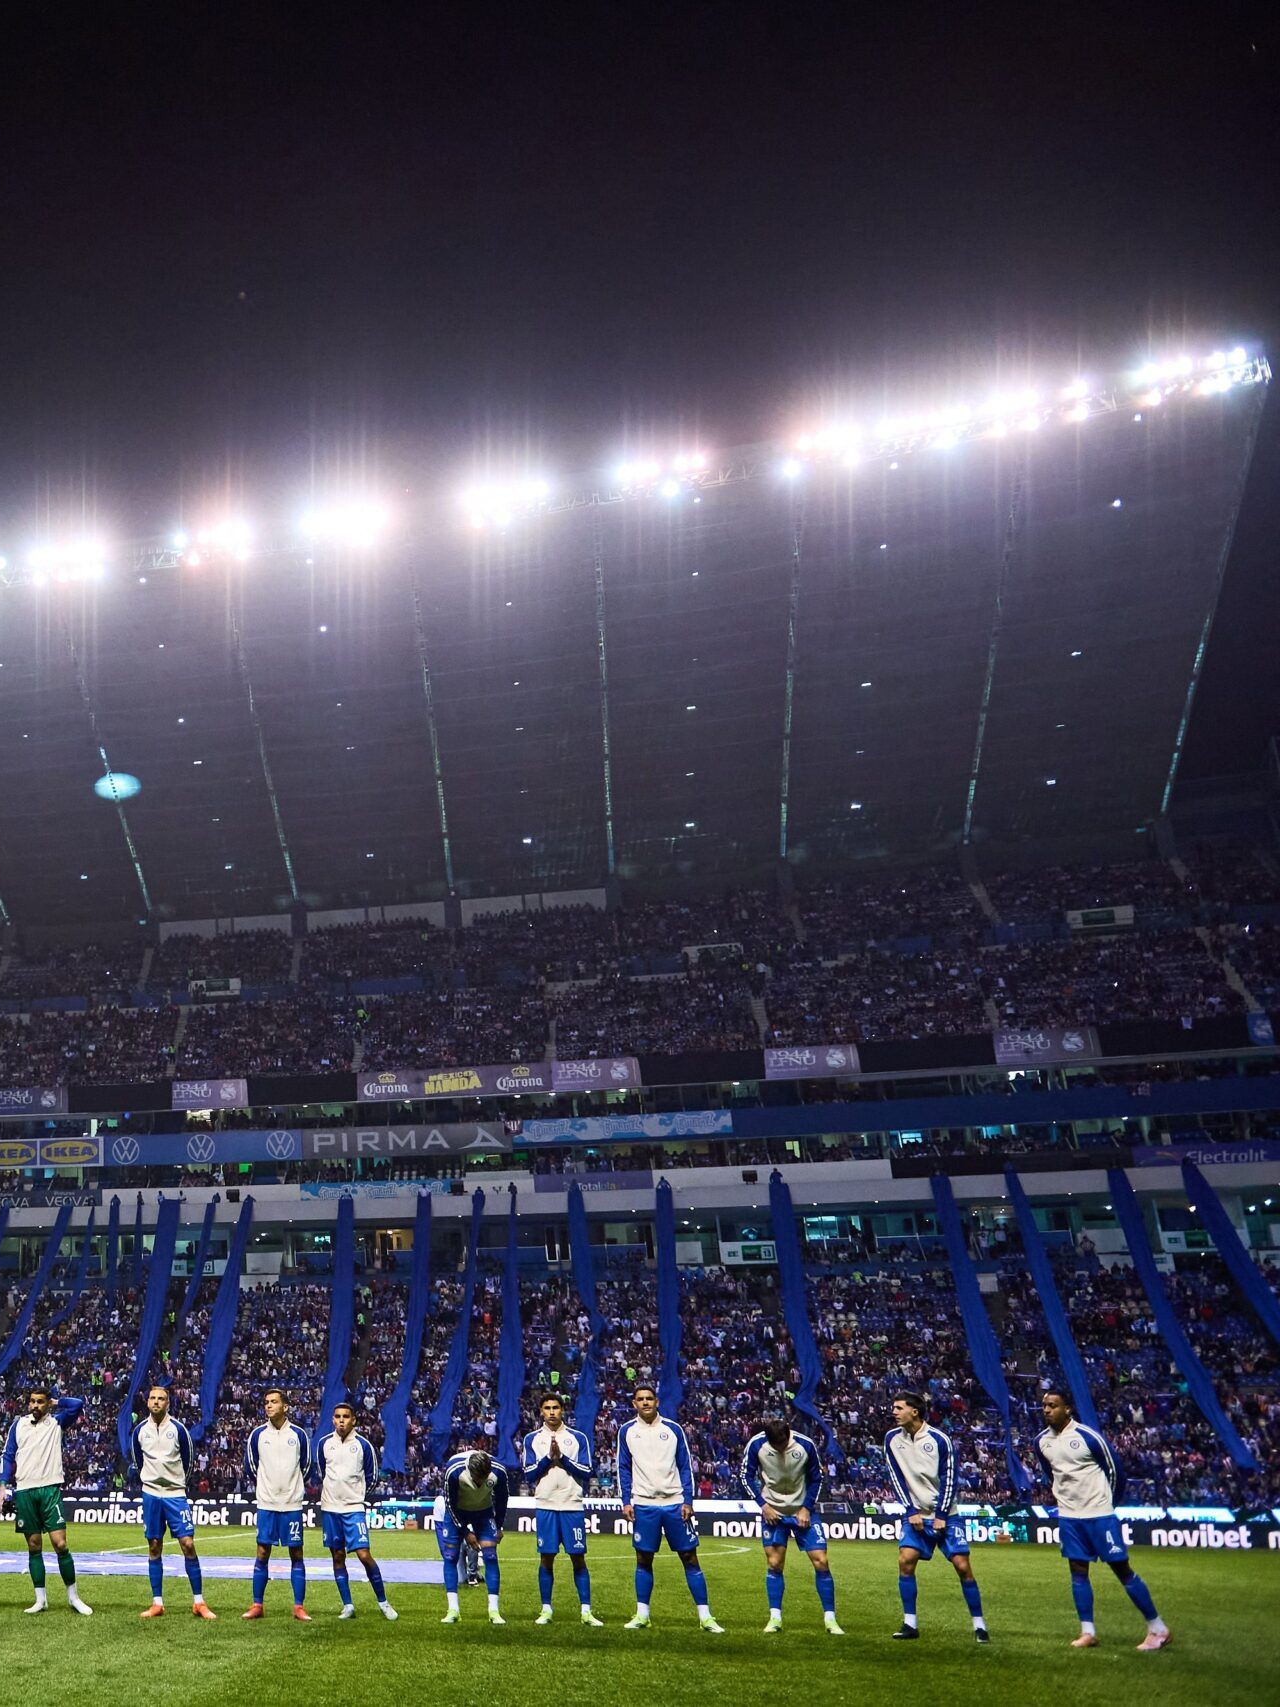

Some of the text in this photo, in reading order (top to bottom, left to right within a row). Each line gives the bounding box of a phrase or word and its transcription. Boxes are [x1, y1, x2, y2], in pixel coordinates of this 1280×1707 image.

[363, 1082, 408, 1097] Corona
[496, 1076, 543, 1091] Corona
[313, 1129, 450, 1153] PIRMA
[45, 1146, 94, 1158] IKEA
[74, 1504, 143, 1523] novibet
[289, 1521, 301, 1534] 22
[1106, 1531, 1114, 1544] 4
[1151, 1523, 1252, 1548] novibet
